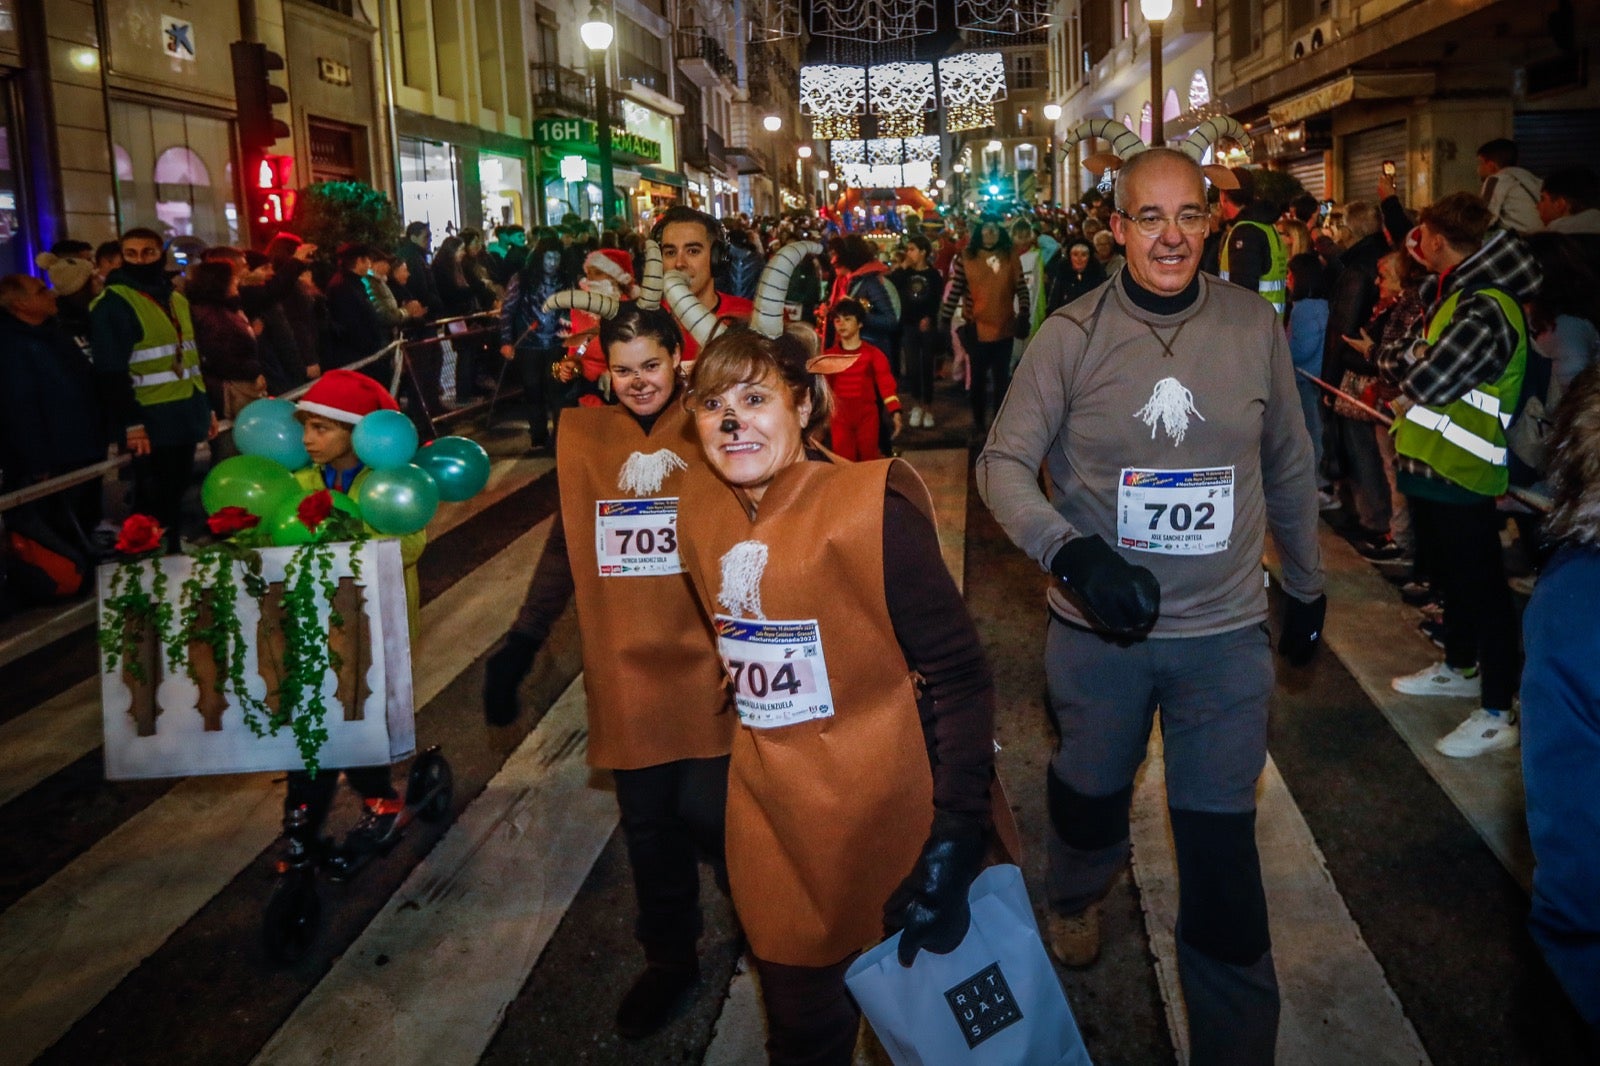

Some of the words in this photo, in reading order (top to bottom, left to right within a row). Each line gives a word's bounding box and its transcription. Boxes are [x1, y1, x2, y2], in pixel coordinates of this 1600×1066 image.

[539, 121, 580, 141] 16H
[588, 121, 660, 159] FRMACIA
[1144, 502, 1215, 531] 702
[615, 528, 677, 554] 703
[728, 660, 801, 697] 704
